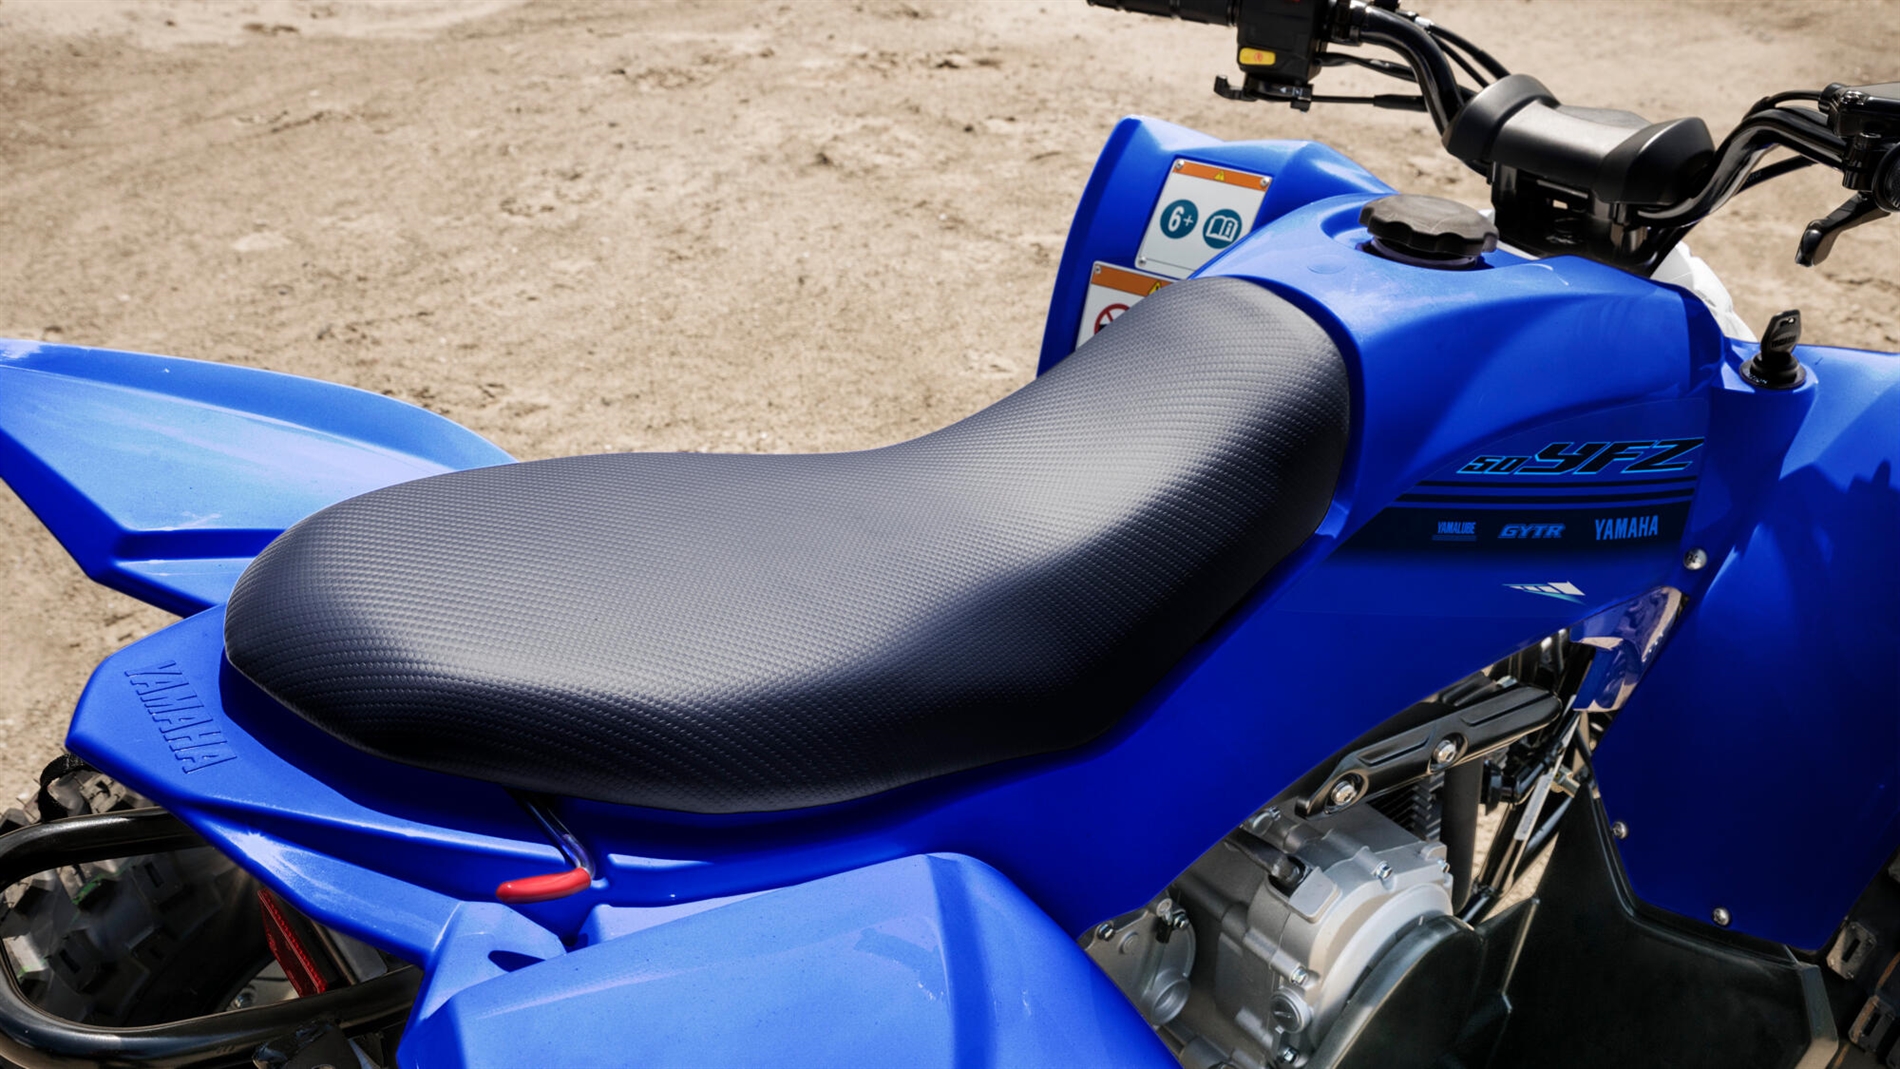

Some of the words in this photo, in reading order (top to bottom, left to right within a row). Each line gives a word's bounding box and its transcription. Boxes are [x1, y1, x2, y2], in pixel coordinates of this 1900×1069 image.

[1456, 455, 1532, 475] 50
[1512, 436, 1705, 475] YFZ
[1437, 520, 1477, 535] YAMALUBE
[1498, 522, 1566, 539] GYTR
[1595, 515, 1659, 541] YAMAHA
[124, 659, 238, 775] YAMAHA
